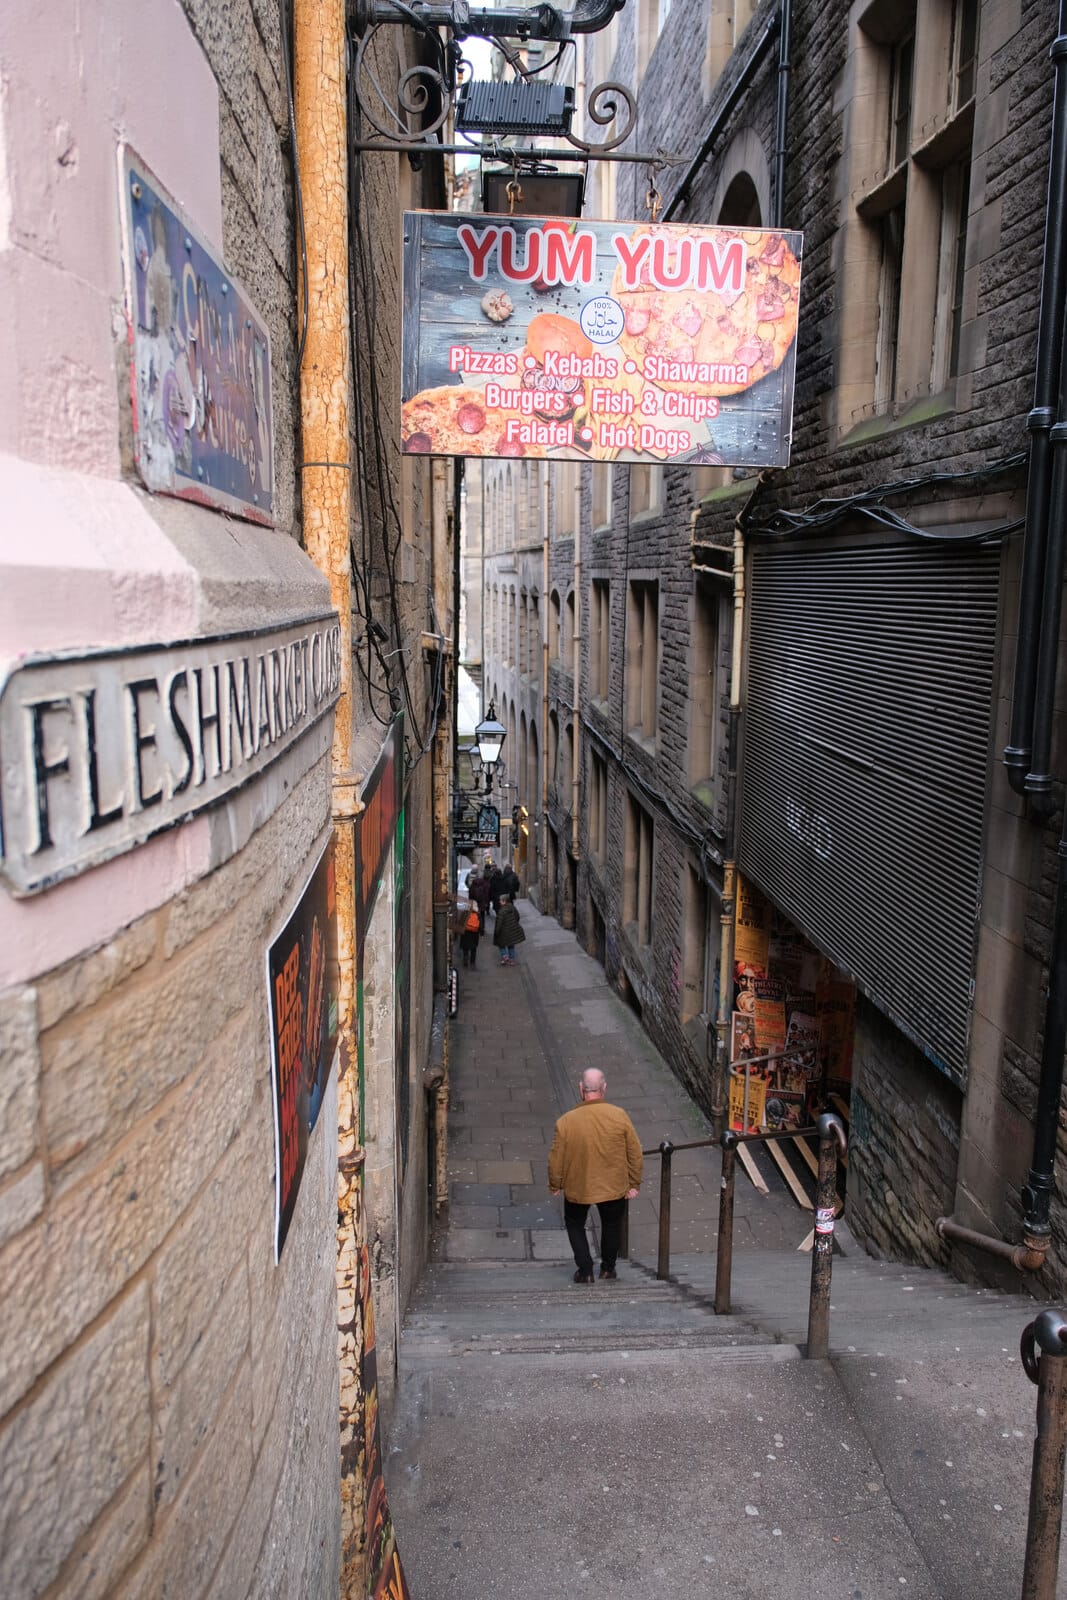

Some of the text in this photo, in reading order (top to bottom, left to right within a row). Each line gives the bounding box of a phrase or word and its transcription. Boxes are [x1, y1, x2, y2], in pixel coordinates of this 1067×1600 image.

[458, 225, 747, 294] YUM YUM
[587, 311, 617, 328] حلال
[589, 329, 615, 337] HALAL
[450, 347, 748, 384] Pizzas Kebabs Shawarma
[486, 384, 720, 421] Burgers Fish & Chips
[506, 419, 690, 455] Falafel Hot Dogs
[22, 636, 309, 856] FLESHMARKET
[276, 942, 300, 1035] DEEP
[279, 991, 303, 1095] FRIED
[282, 1113, 300, 1212] BAR
